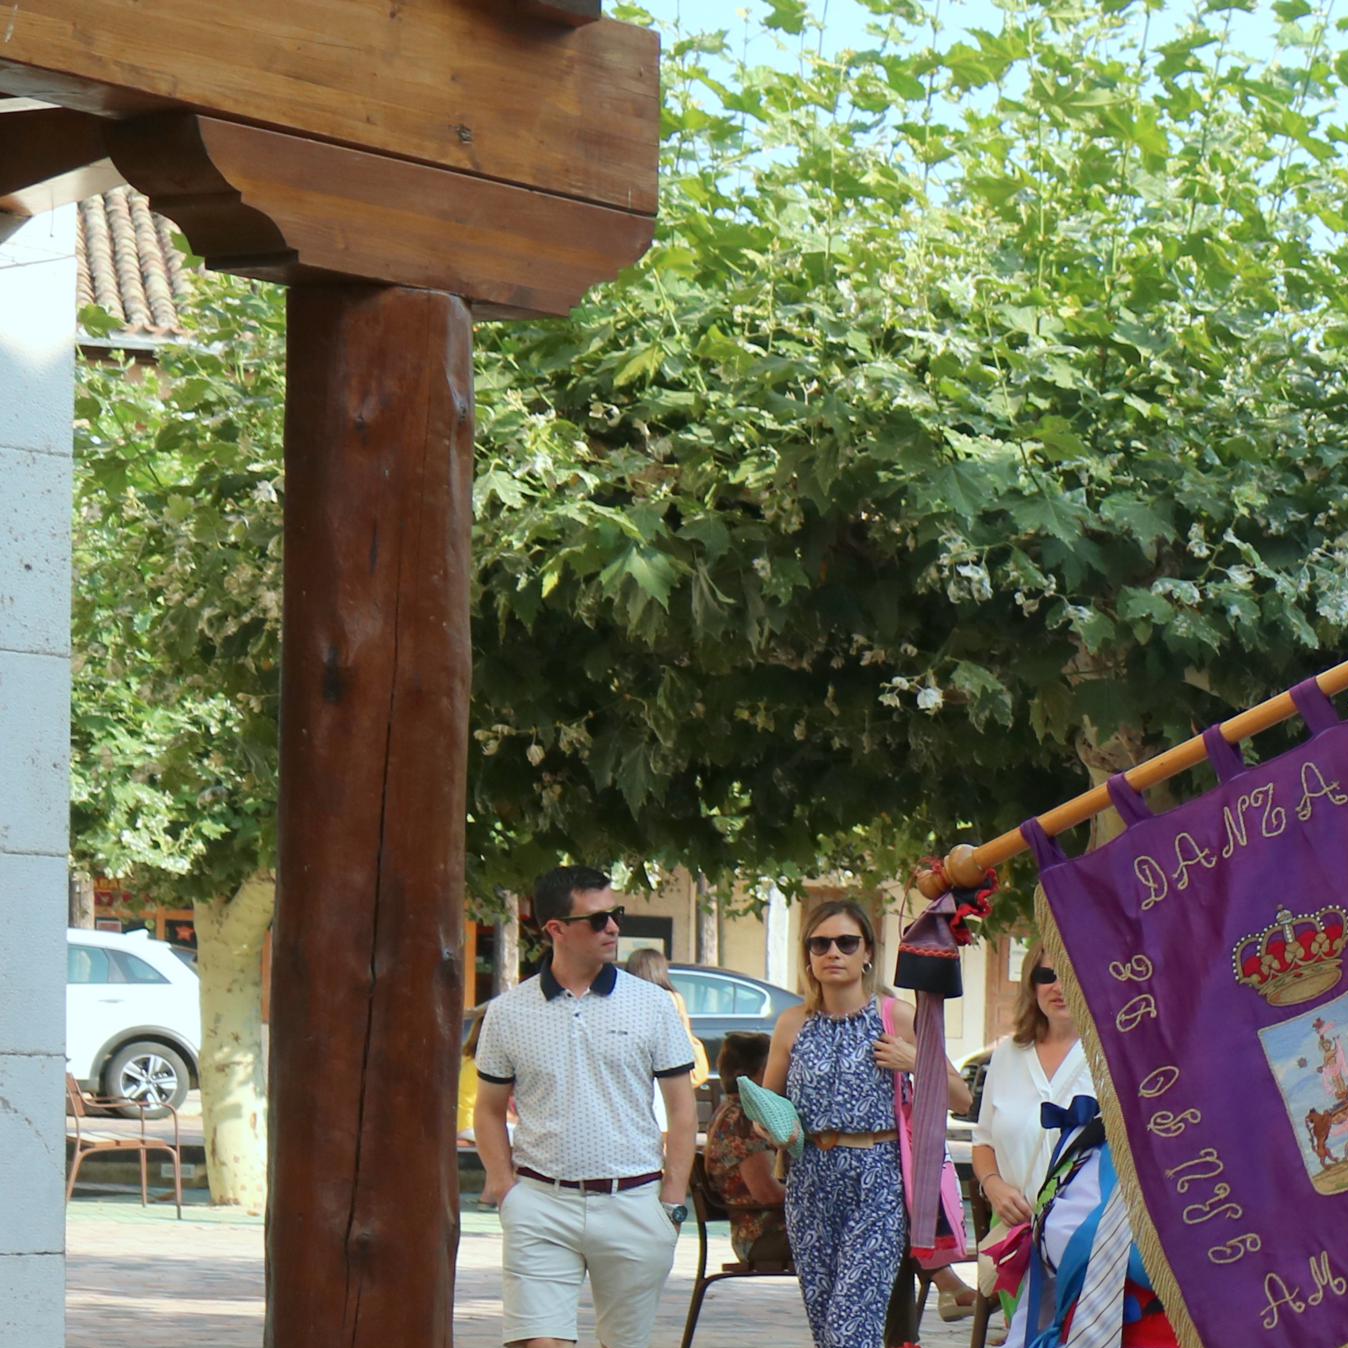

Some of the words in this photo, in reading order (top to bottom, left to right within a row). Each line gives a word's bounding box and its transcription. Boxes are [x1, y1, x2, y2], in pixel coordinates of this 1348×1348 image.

[1134, 761, 1348, 911] DANZA
[1108, 954, 1158, 1033] DE
[1137, 1064, 1262, 1264] GRUPO
